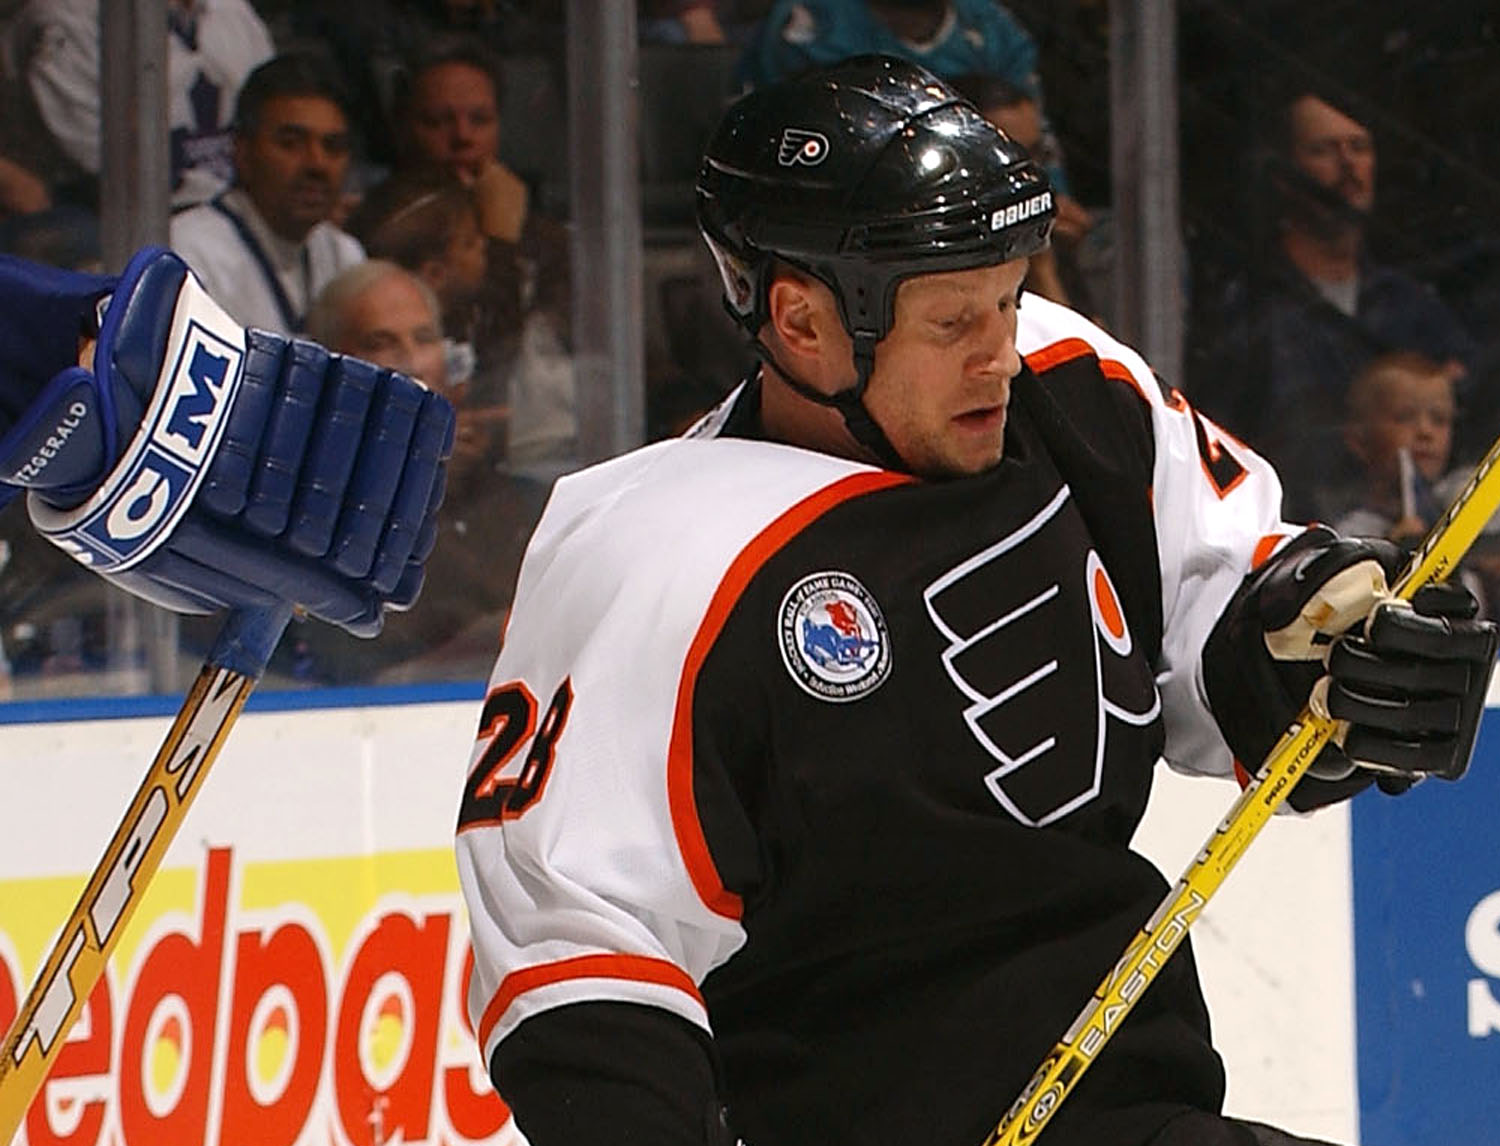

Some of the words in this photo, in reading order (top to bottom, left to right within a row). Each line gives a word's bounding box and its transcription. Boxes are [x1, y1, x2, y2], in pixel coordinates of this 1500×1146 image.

[991, 191, 1052, 231] BAUER
[58, 339, 231, 565] CM
[456, 675, 575, 836] 28
[1264, 777, 1288, 806] PRO
[1079, 891, 1205, 1056] EASTON
